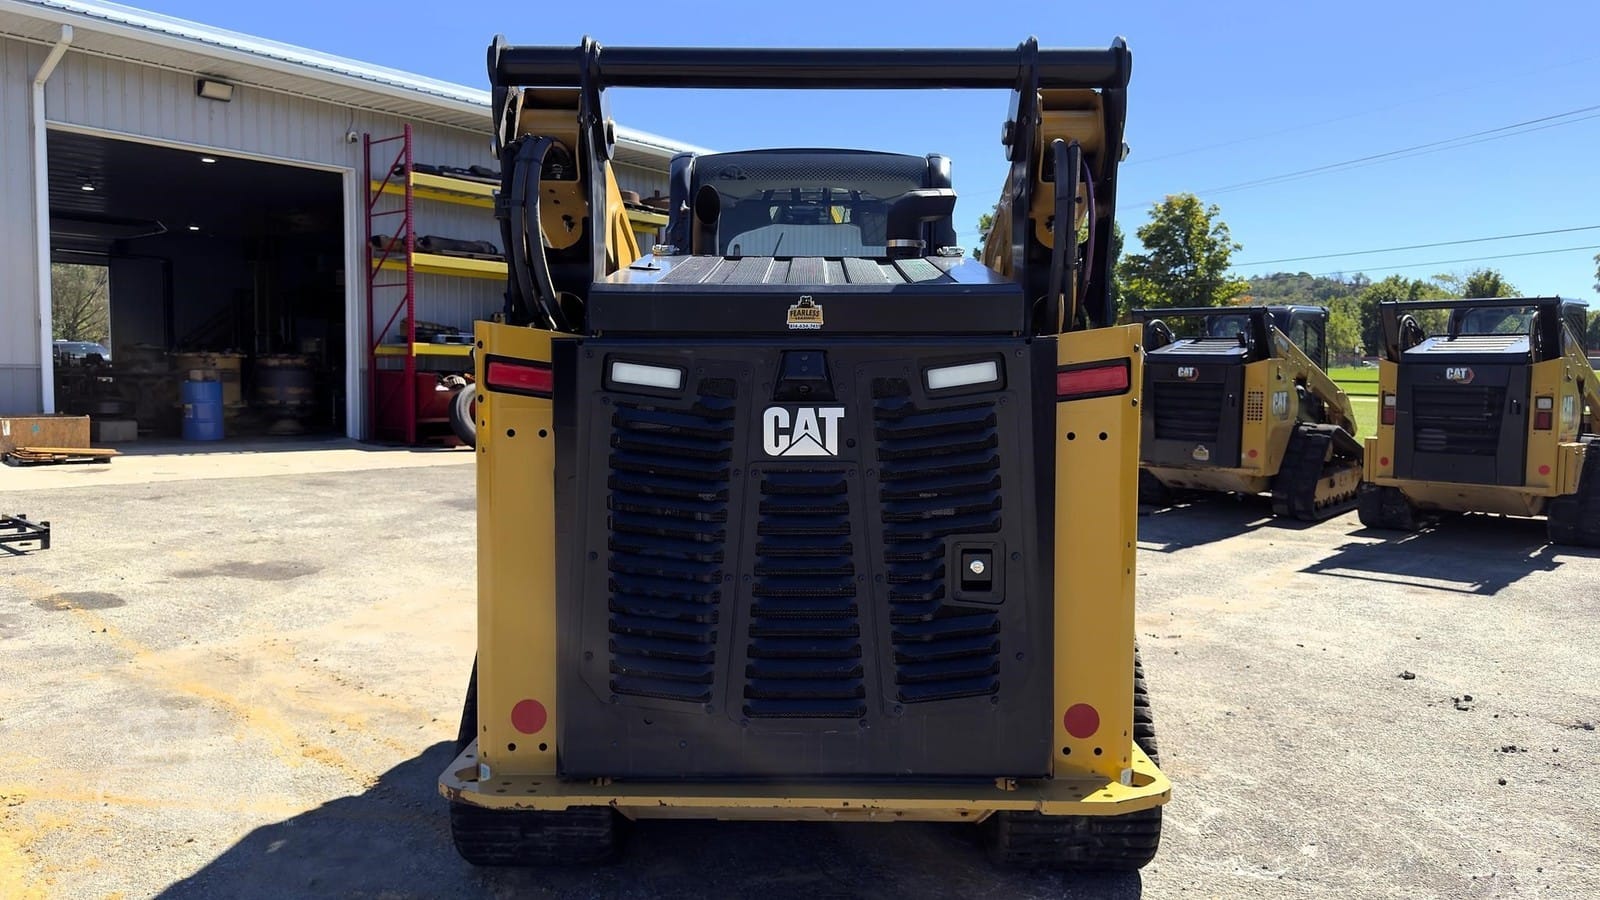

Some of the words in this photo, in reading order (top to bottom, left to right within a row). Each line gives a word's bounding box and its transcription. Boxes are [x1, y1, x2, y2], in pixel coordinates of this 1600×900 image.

[790, 309, 820, 317] FEARLESS
[1178, 366, 1194, 377] CAT
[1446, 367, 1468, 380] CAT
[1272, 391, 1288, 416] CAT
[763, 406, 845, 456] CAT
